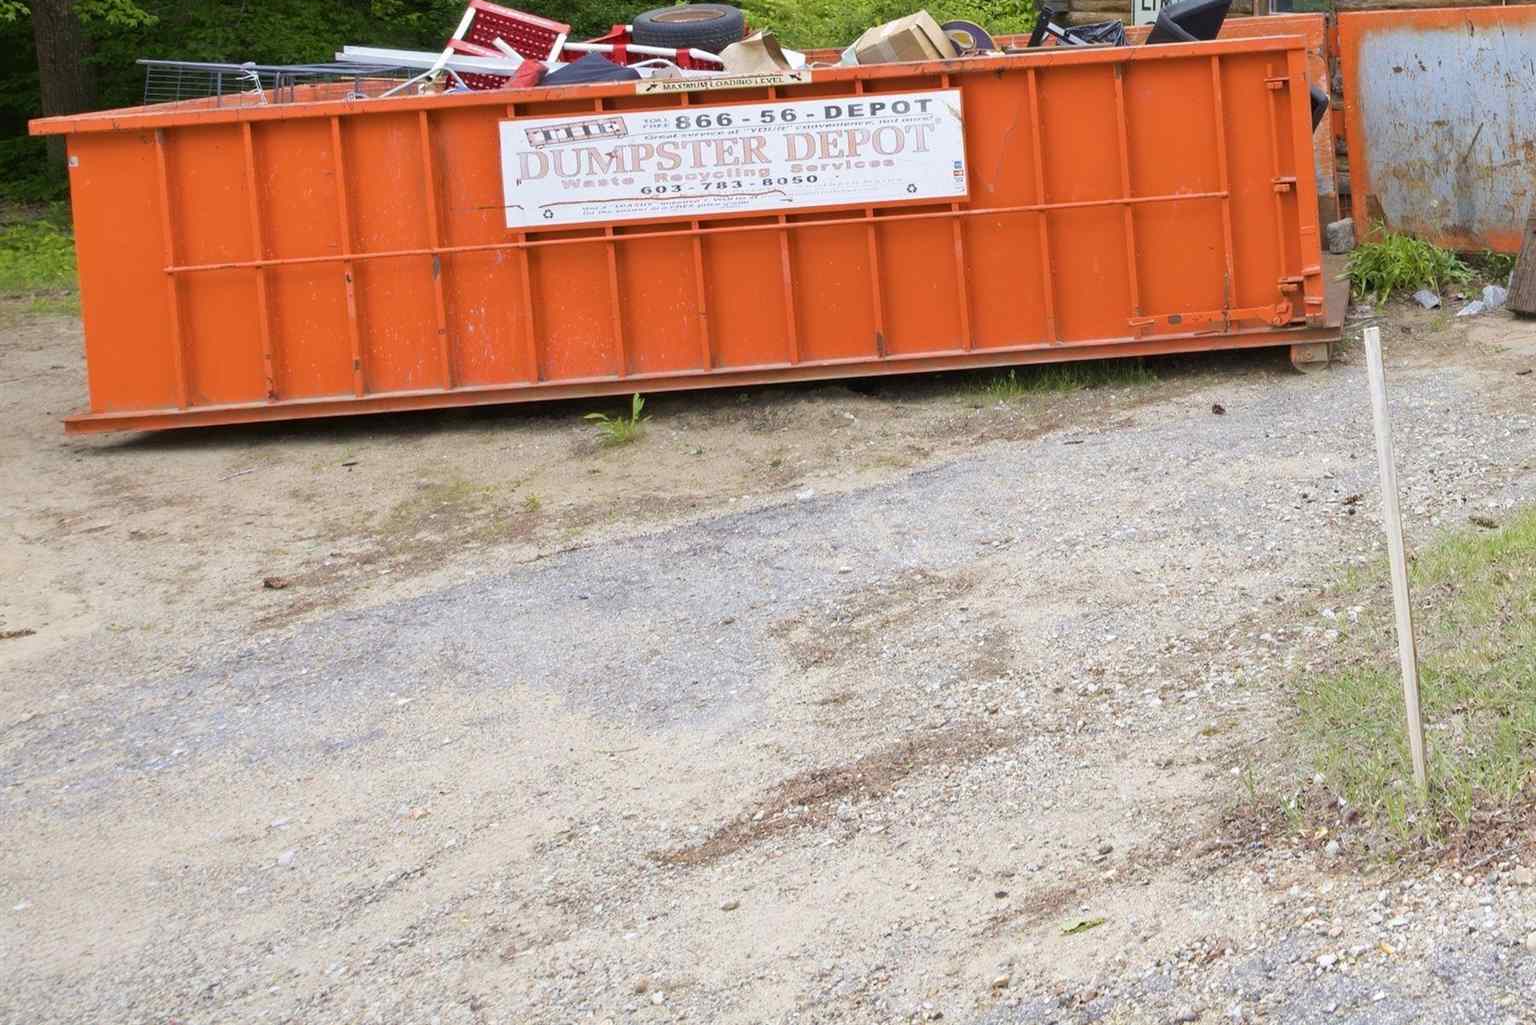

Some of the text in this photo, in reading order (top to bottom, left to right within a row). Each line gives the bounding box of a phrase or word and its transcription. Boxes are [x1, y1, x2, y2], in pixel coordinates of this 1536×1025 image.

[663, 77, 784, 90] MAXIMUM LOADING LEVEL
[516, 124, 935, 181] DUMPSTER DEPOT
[561, 159, 896, 189] Waste Recycling Services
